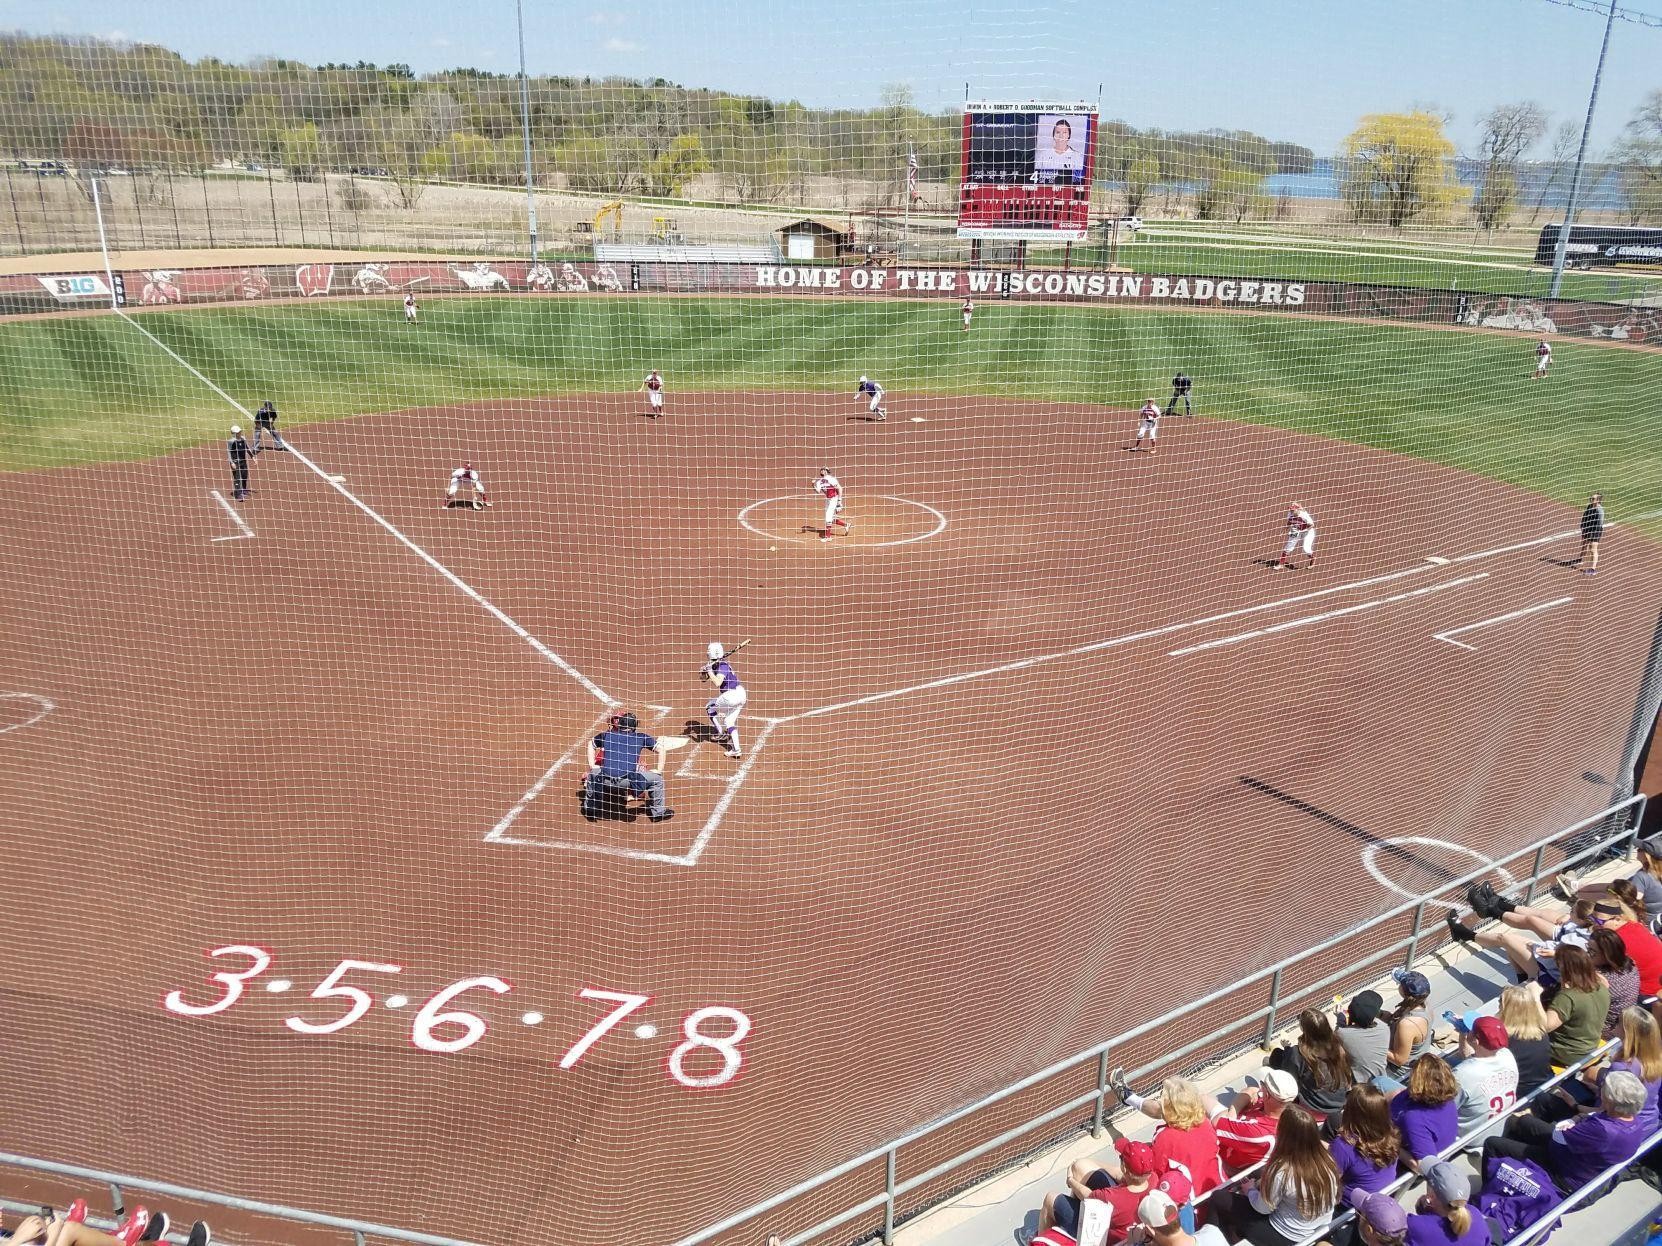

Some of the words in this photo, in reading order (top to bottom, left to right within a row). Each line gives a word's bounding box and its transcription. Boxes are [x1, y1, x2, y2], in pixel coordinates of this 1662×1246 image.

[1030, 170, 1039, 183] 4
[755, 267, 841, 288] HOME
[851, 269, 887, 289] OF
[897, 271, 956, 291] THE
[967, 272, 1144, 297] WISCONSIN
[1150, 277, 1304, 305] BADGERS
